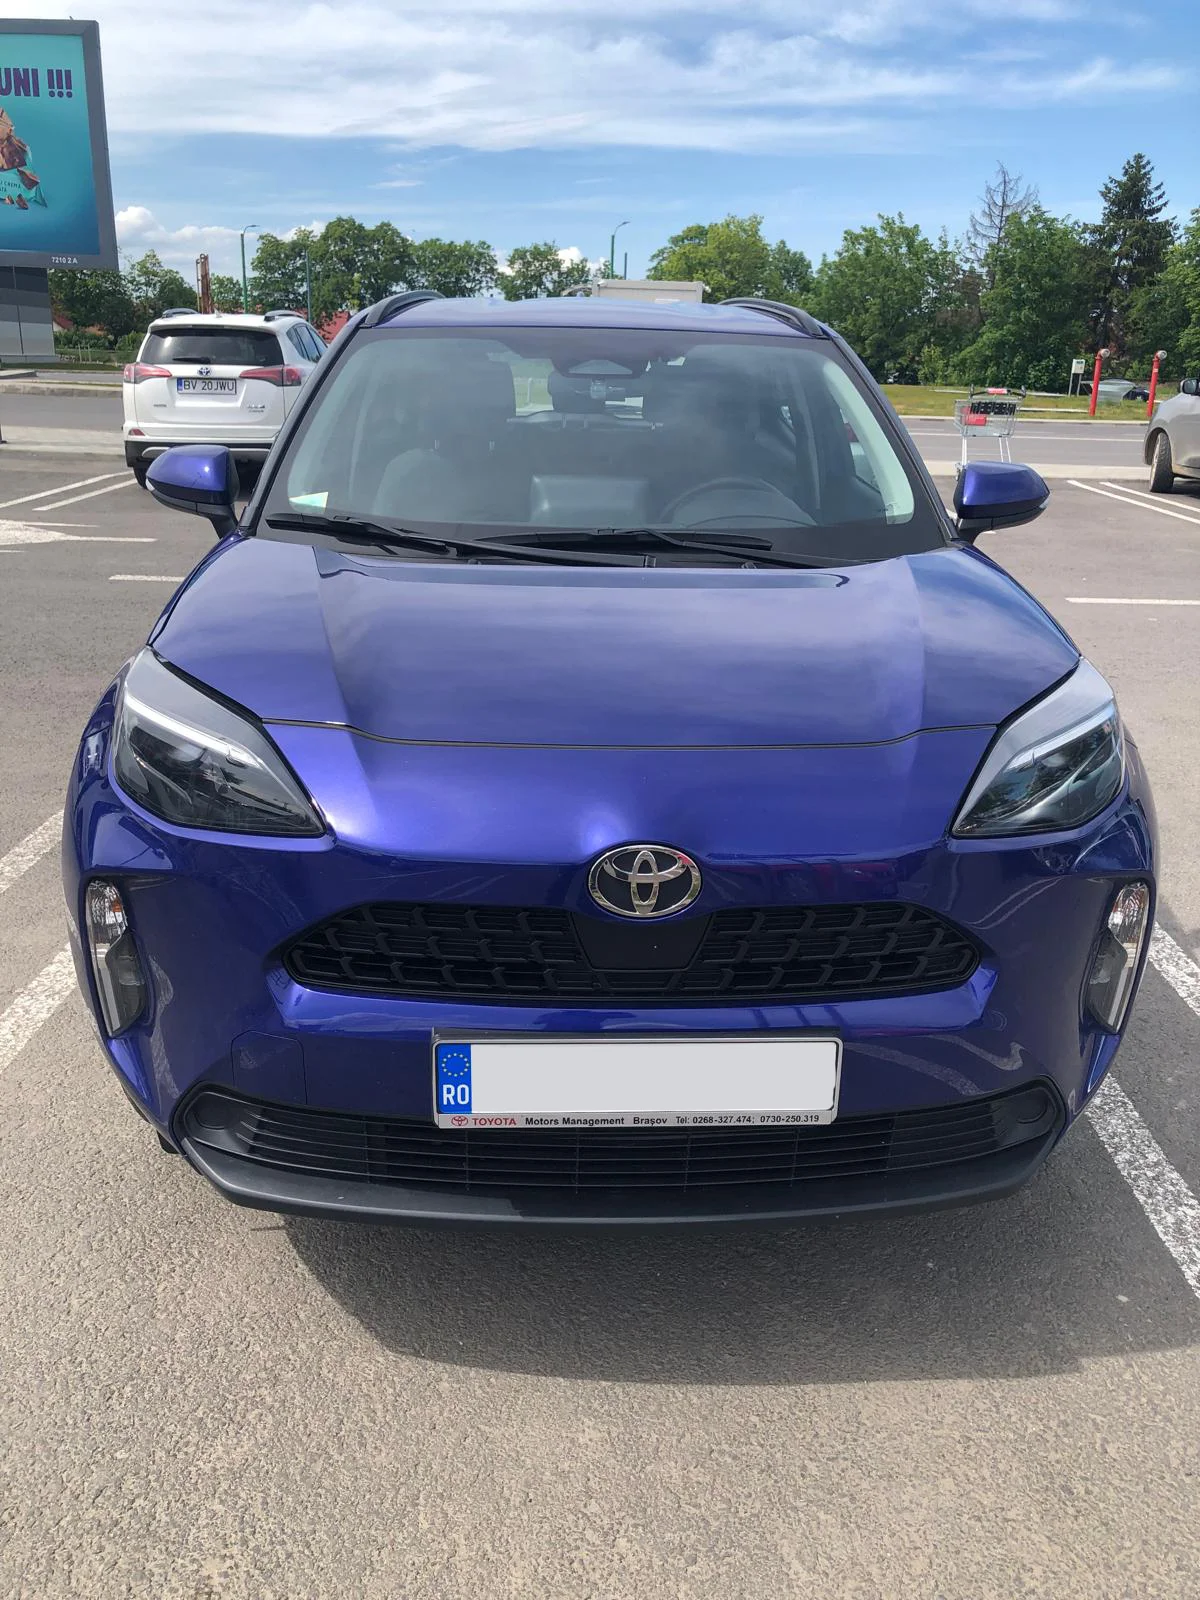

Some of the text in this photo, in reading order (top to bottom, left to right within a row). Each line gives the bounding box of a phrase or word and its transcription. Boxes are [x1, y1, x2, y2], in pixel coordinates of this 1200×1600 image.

[0, 67, 73, 98] UNI !!!
[183, 380, 235, 391] BV 20 JWU
[442, 1084, 470, 1106] RO
[472, 1117, 517, 1126] TOYOTA
[525, 1117, 559, 1126] Motors
[562, 1117, 625, 1127] Management
[676, 1116, 690, 1124] Tel:
[692, 1115, 755, 1125] 0268-327.474;
[760, 1114, 820, 1123] 0730-250.319
